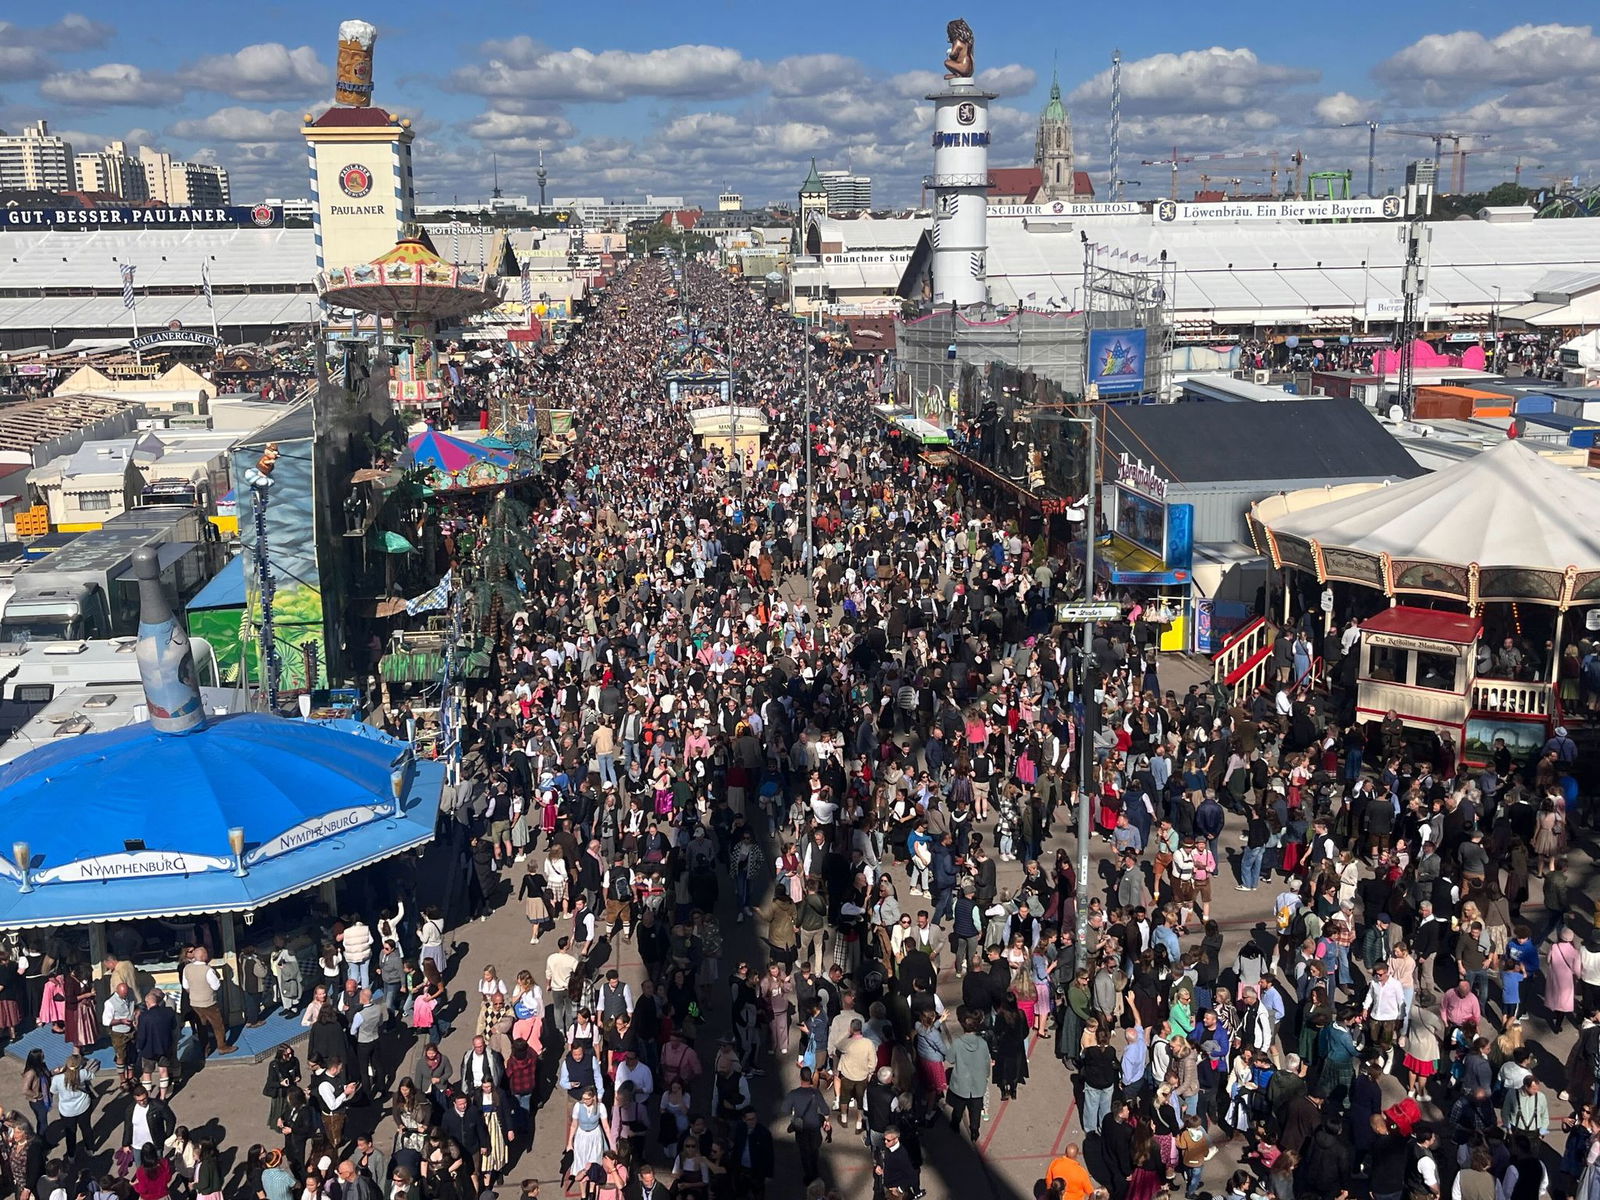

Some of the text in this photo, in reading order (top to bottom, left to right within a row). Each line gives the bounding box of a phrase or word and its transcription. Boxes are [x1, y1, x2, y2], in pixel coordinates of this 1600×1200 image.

[8, 209, 233, 225] GUT, BESSER, PAULANER.
[330, 205, 385, 215] PAULANER
[1184, 203, 1376, 218] Löwenbräu. Ein Bier wie Bayern.
[833, 254, 884, 263] Münchner
[133, 331, 221, 348] PAULANERGARTEN
[1375, 635, 1386, 643] Die
[280, 811, 359, 850] NYMPHENBURG
[80, 857, 187, 877] NYMPHENBURG
